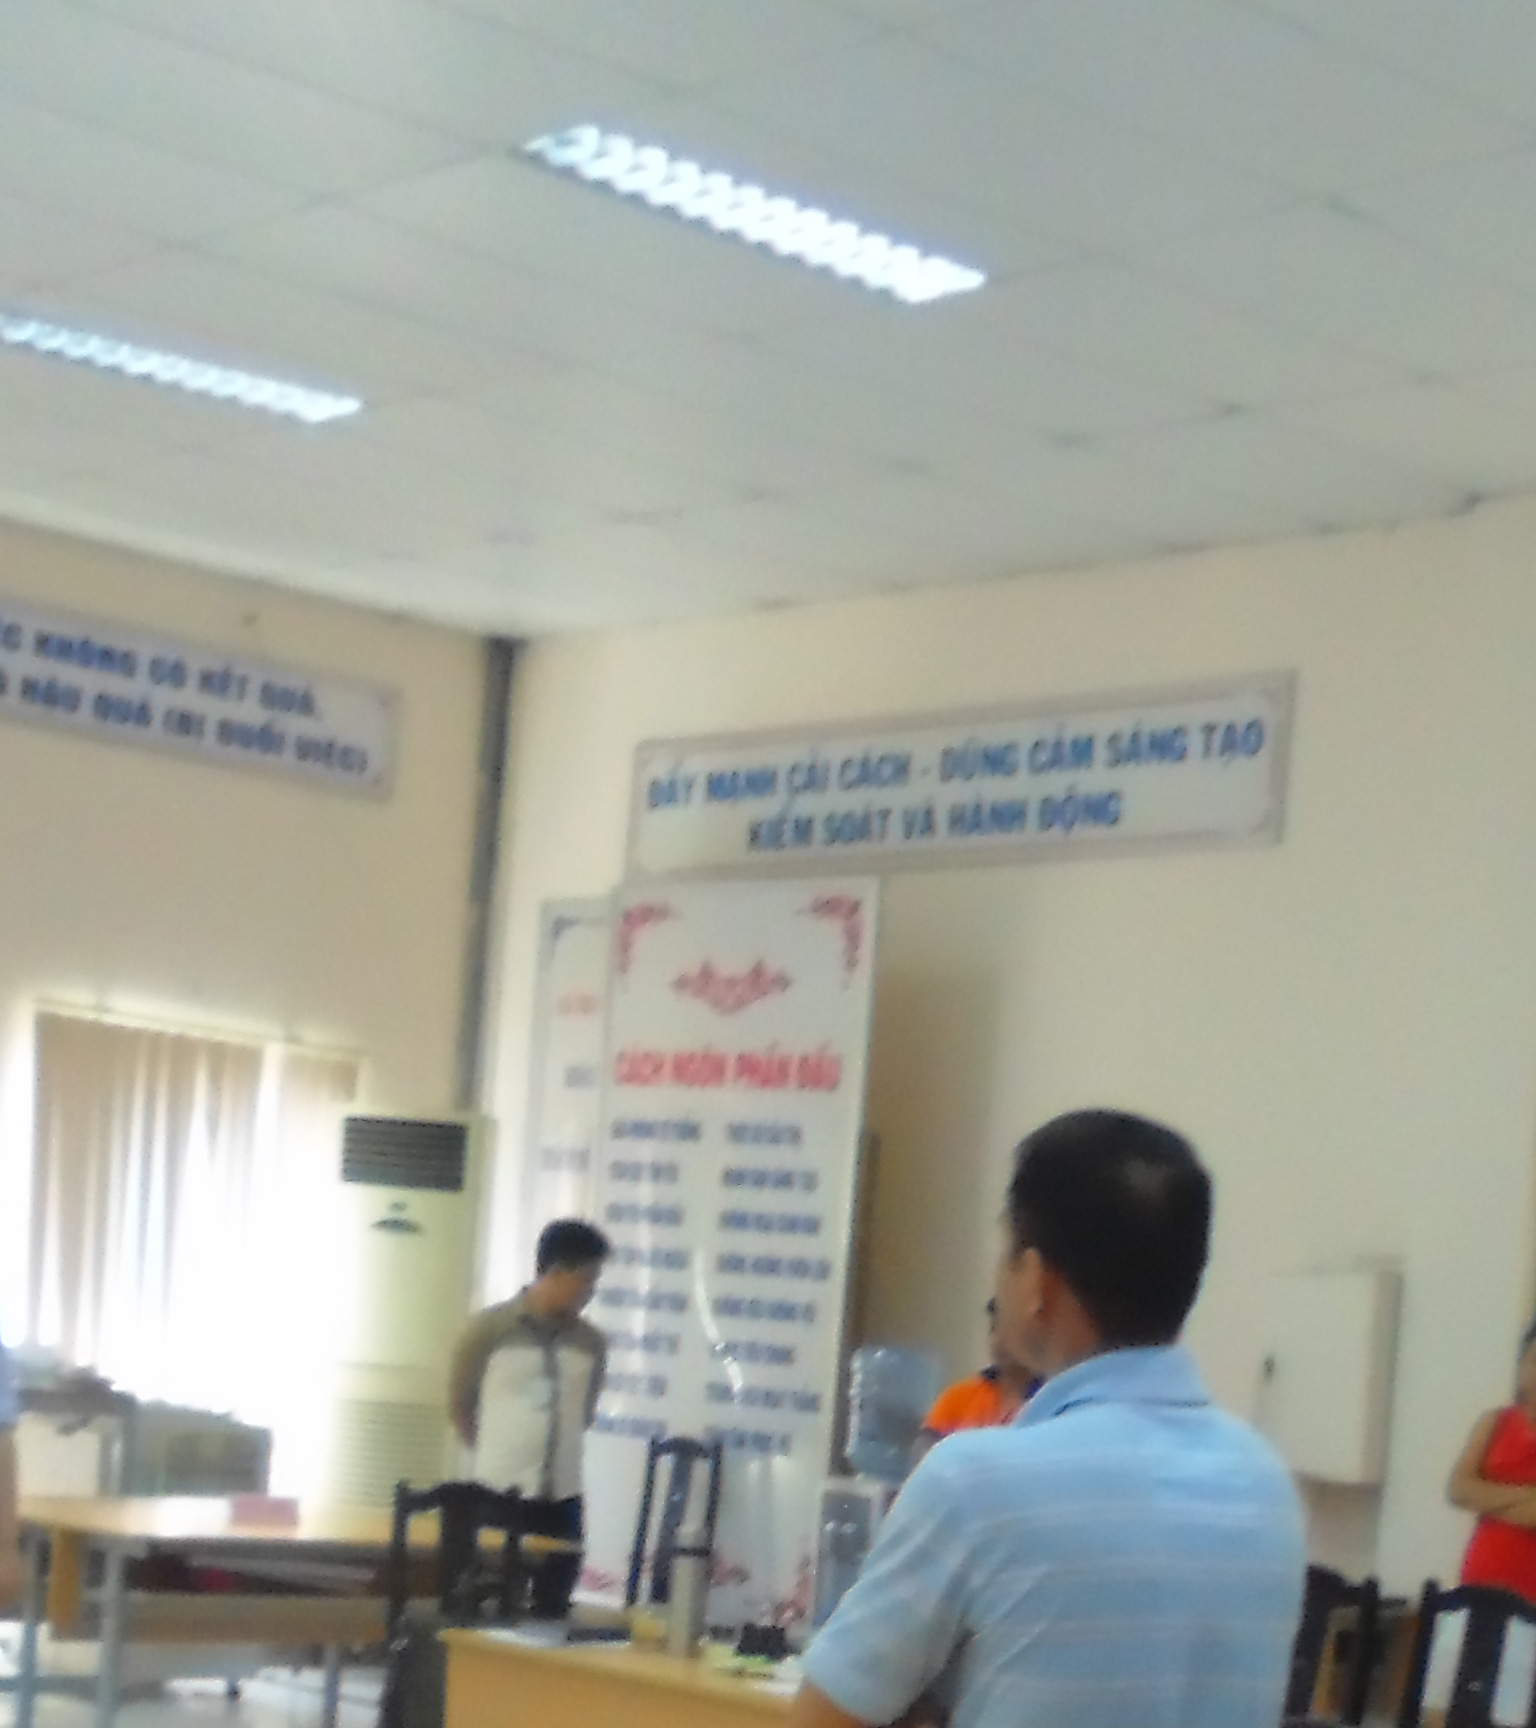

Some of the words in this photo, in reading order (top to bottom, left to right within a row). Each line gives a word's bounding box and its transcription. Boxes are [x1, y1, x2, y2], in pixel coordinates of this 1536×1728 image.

[33, 627, 138, 679] KHÔNG
[1028, 722, 1096, 776] CẢM
[1104, 718, 1190, 768] SÁNG
[1198, 717, 1266, 766] TẠO
[821, 803, 894, 846] SOÁT
